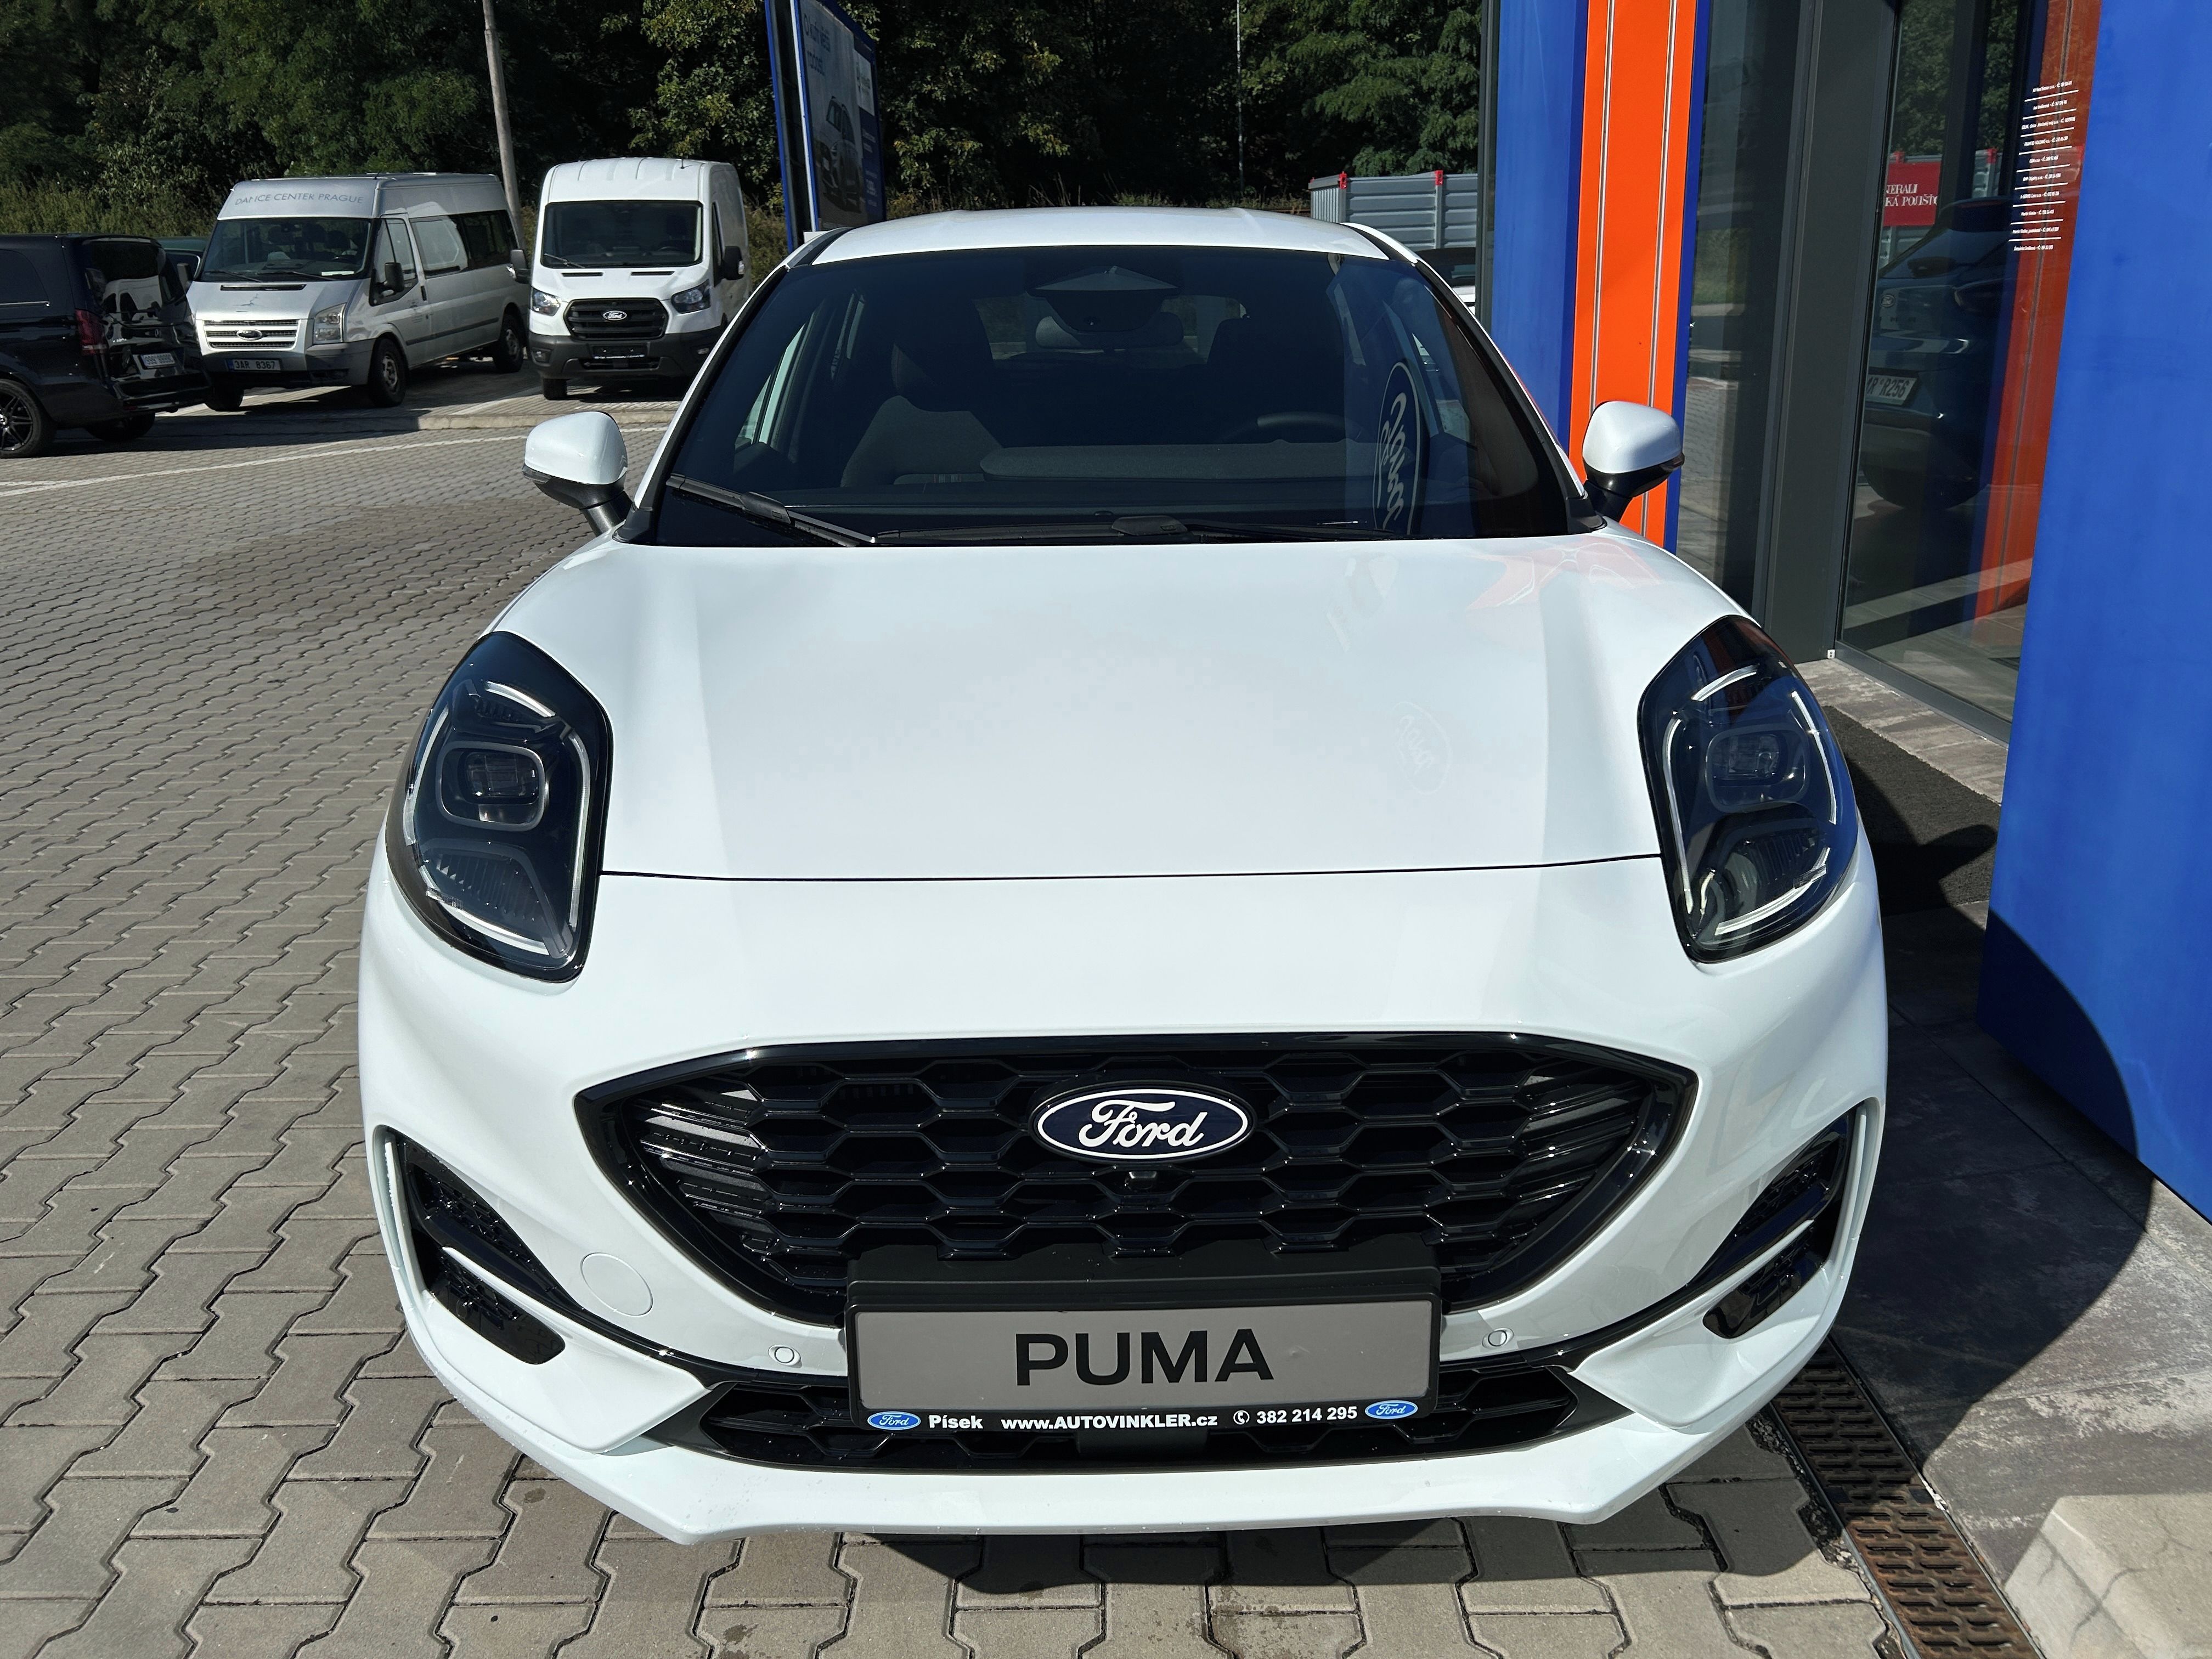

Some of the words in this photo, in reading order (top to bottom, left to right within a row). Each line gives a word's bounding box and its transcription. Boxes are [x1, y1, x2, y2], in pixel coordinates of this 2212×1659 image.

[235, 194, 270, 206] DANCE
[274, 193, 314, 201] CENTER
[318, 193, 364, 204] PRAGUE
[234, 360, 251, 369] 3AR
[255, 360, 275, 369] 8367
[1078, 1099, 1208, 1148] Ford
[1015, 1328, 1274, 1386] PUMA
[928, 1414, 983, 1429] Písek
[1001, 1413, 1218, 1430] www.AUTOVINKLER.cz
[1256, 1409, 1287, 1424] 382
[1291, 1408, 1322, 1423] 214
[1327, 1406, 1357, 1420] 295
